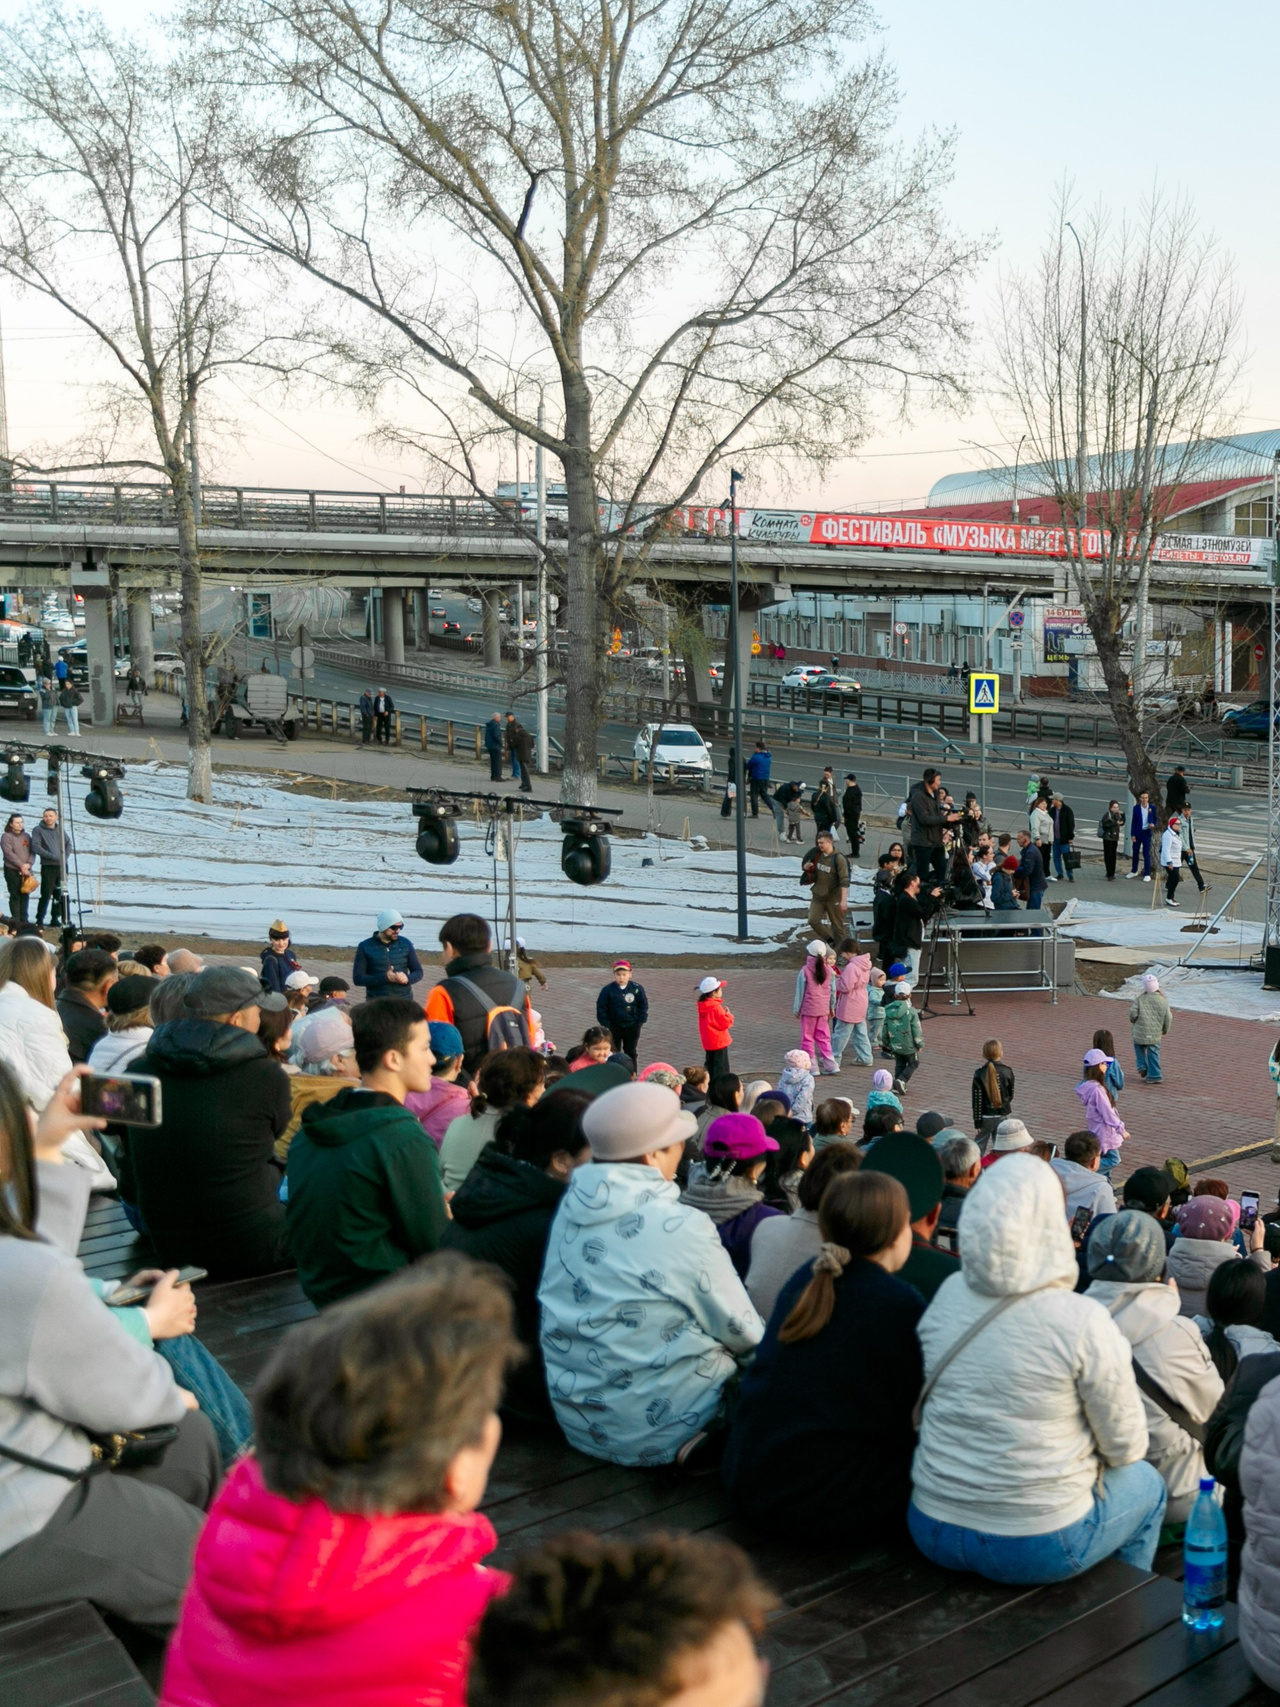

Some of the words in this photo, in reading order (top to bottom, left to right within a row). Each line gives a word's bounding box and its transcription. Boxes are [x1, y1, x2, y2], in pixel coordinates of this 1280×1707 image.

[821, 518, 927, 545] ФЕСТИВАЛЬ
[933, 523, 1016, 550] «МУЗЫКА
[1174, 537, 1193, 550] МАЯ
[1202, 538, 1252, 553] ЭТНОМУЗЕЙ
[1056, 608, 1083, 616] БУТИК
